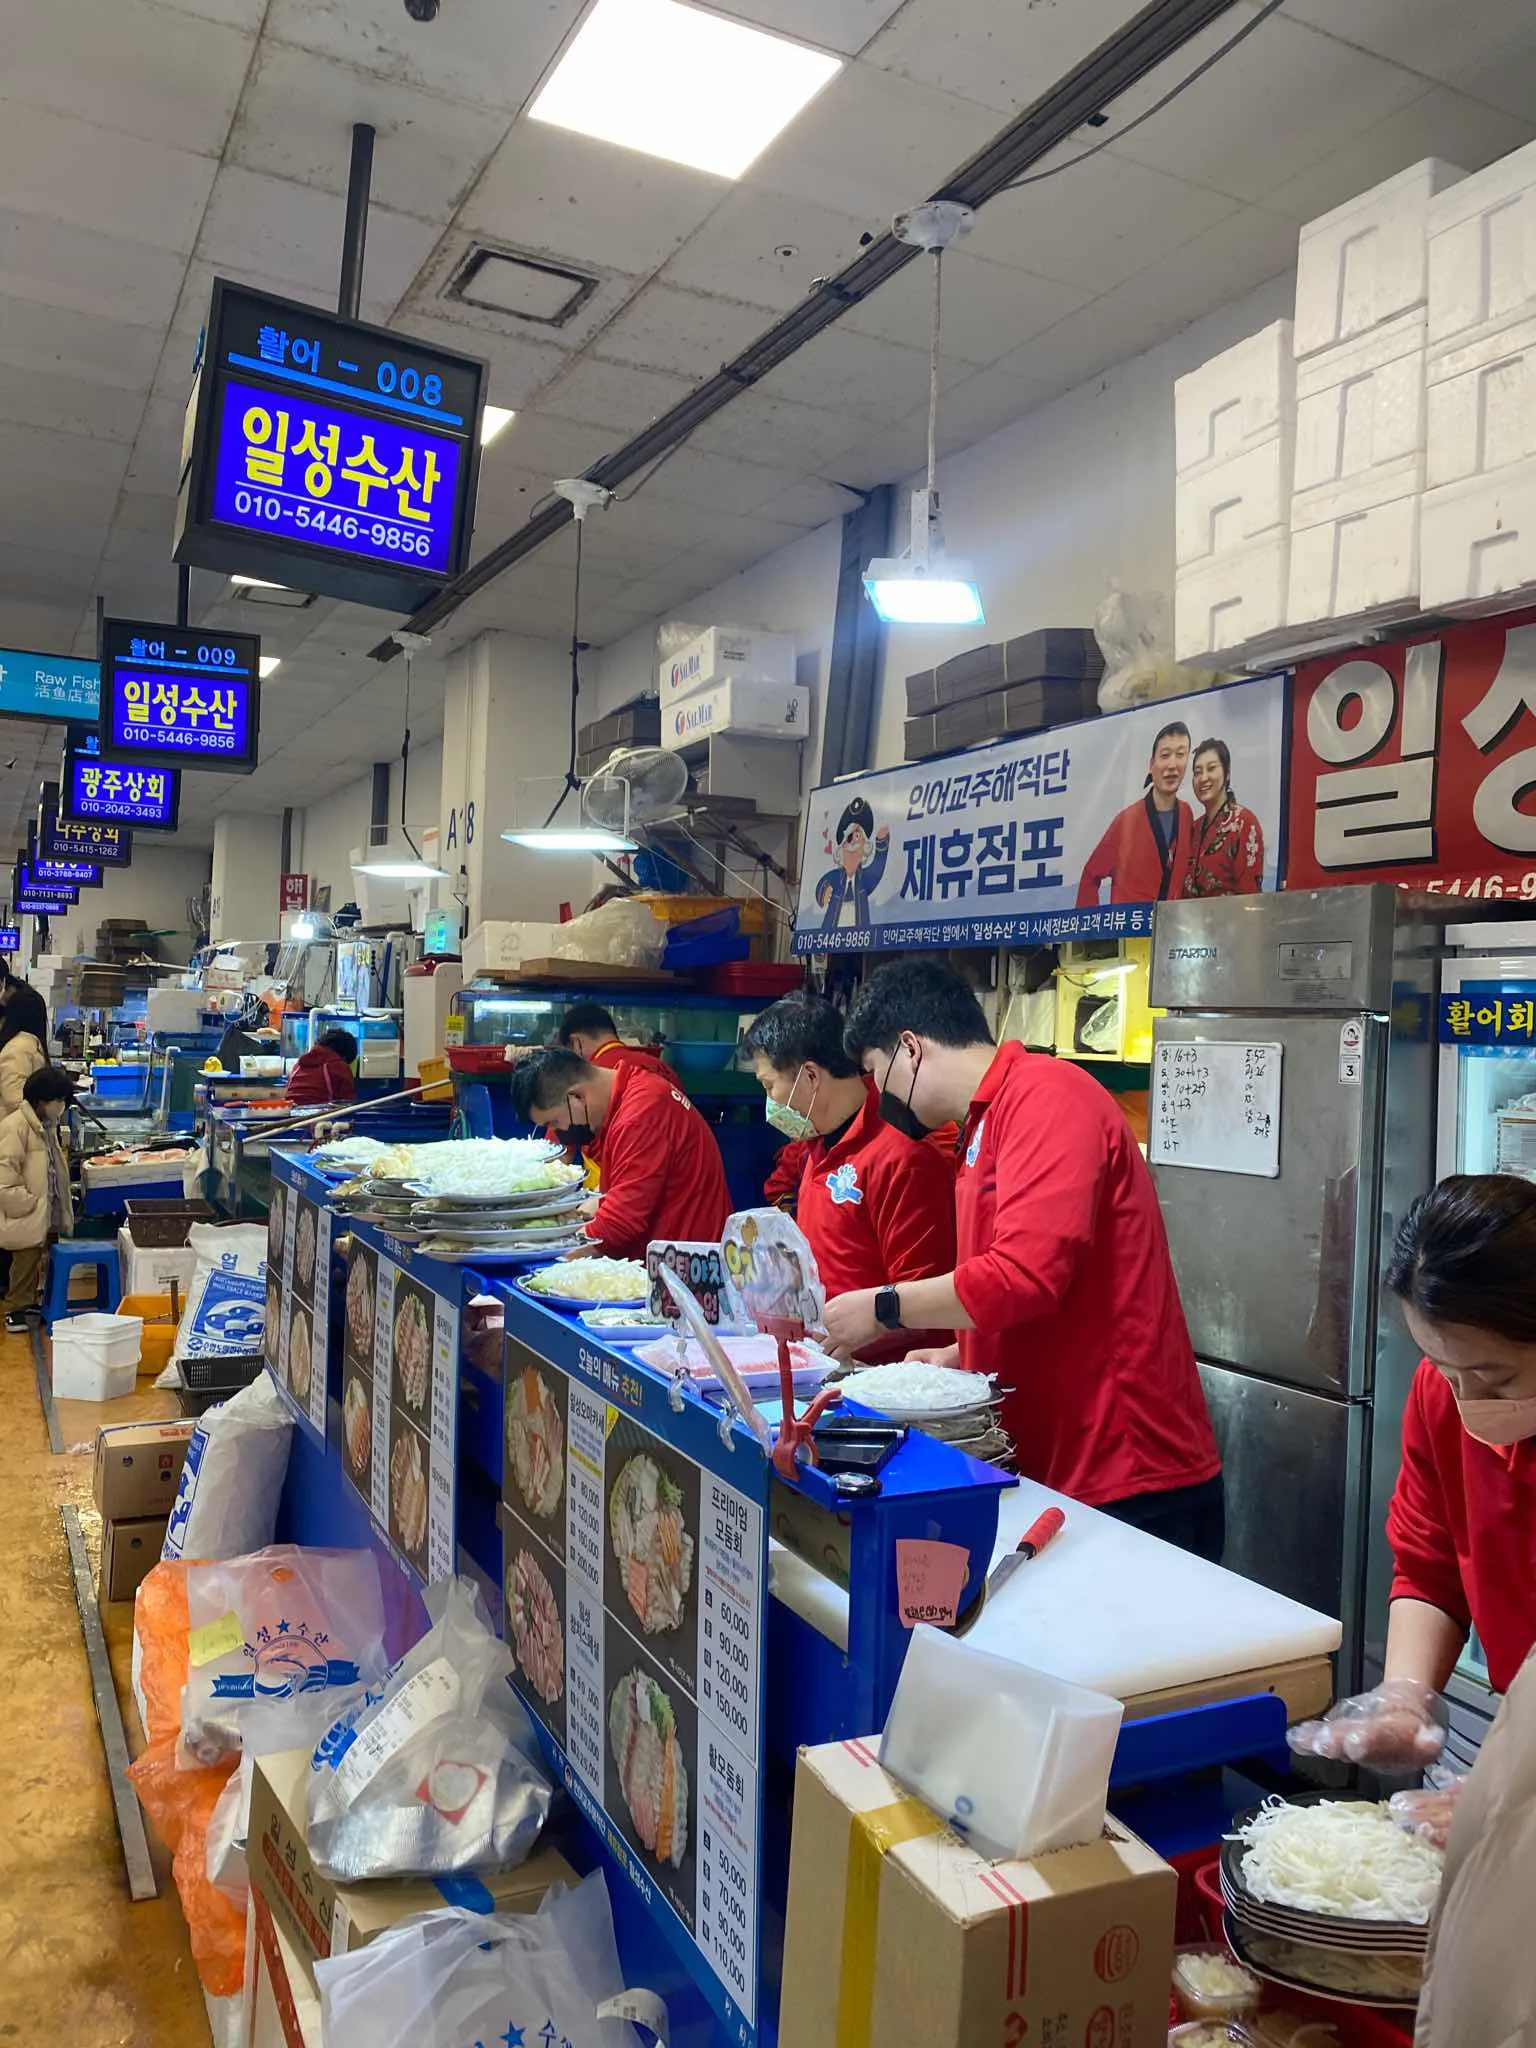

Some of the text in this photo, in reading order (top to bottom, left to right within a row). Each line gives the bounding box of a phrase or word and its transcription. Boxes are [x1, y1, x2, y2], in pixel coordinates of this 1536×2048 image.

[257, 324, 321, 373] 활어
[377, 361, 442, 405] 008
[243, 406, 441, 522] 일성수산
[235, 490, 431, 557] 010-5446-9856
[130, 638, 165, 660] 활어
[198, 646, 236, 665] 009
[35, 670, 67, 687] Raw
[124, 681, 238, 730] 일성수산
[124, 728, 235, 749] 010-5446-9856
[80, 767, 165, 804] 광주상회
[907, 749, 1070, 821] 인어교주해적단
[81, 801, 162, 818] 010-2042-3493
[54, 842, 118, 856] 010-5415-1262
[900, 817, 1064, 901] 제휴점포
[797, 930, 871, 950] 010-5446-9856
[883, 926, 940, 946] 인어교주해적단
[942, 923, 969, 942] 앱에서
[1019, 920, 1029, 938] 의
[1032, 915, 1080, 937] 시세정보와
[1080, 913, 1100, 933] 고객
[1103, 911, 1126, 930] 리뷰
[1130, 910, 1144, 931] 등
[1446, 1000, 1534, 1038] 활어회
[1346, 1064, 1354, 1077] 3
[579, 1348, 600, 1381] 오늘의
[602, 1361, 619, 1392] 메뉴
[712, 1486, 747, 1532] 프리미엄
[715, 1518, 742, 1559] 모둠회
[721, 1602, 749, 1640] 60,000
[720, 1632, 748, 1672] 90,000
[716, 1660, 748, 1703] 120,000
[716, 1690, 748, 1735] 150,000
[709, 1743, 744, 1803] 활모둠회
[719, 1849, 747, 1897] 50,000
[719, 1880, 746, 1929] 70,000
[718, 1912, 745, 1961] 90,000
[714, 1937, 745, 1993] 110,000
